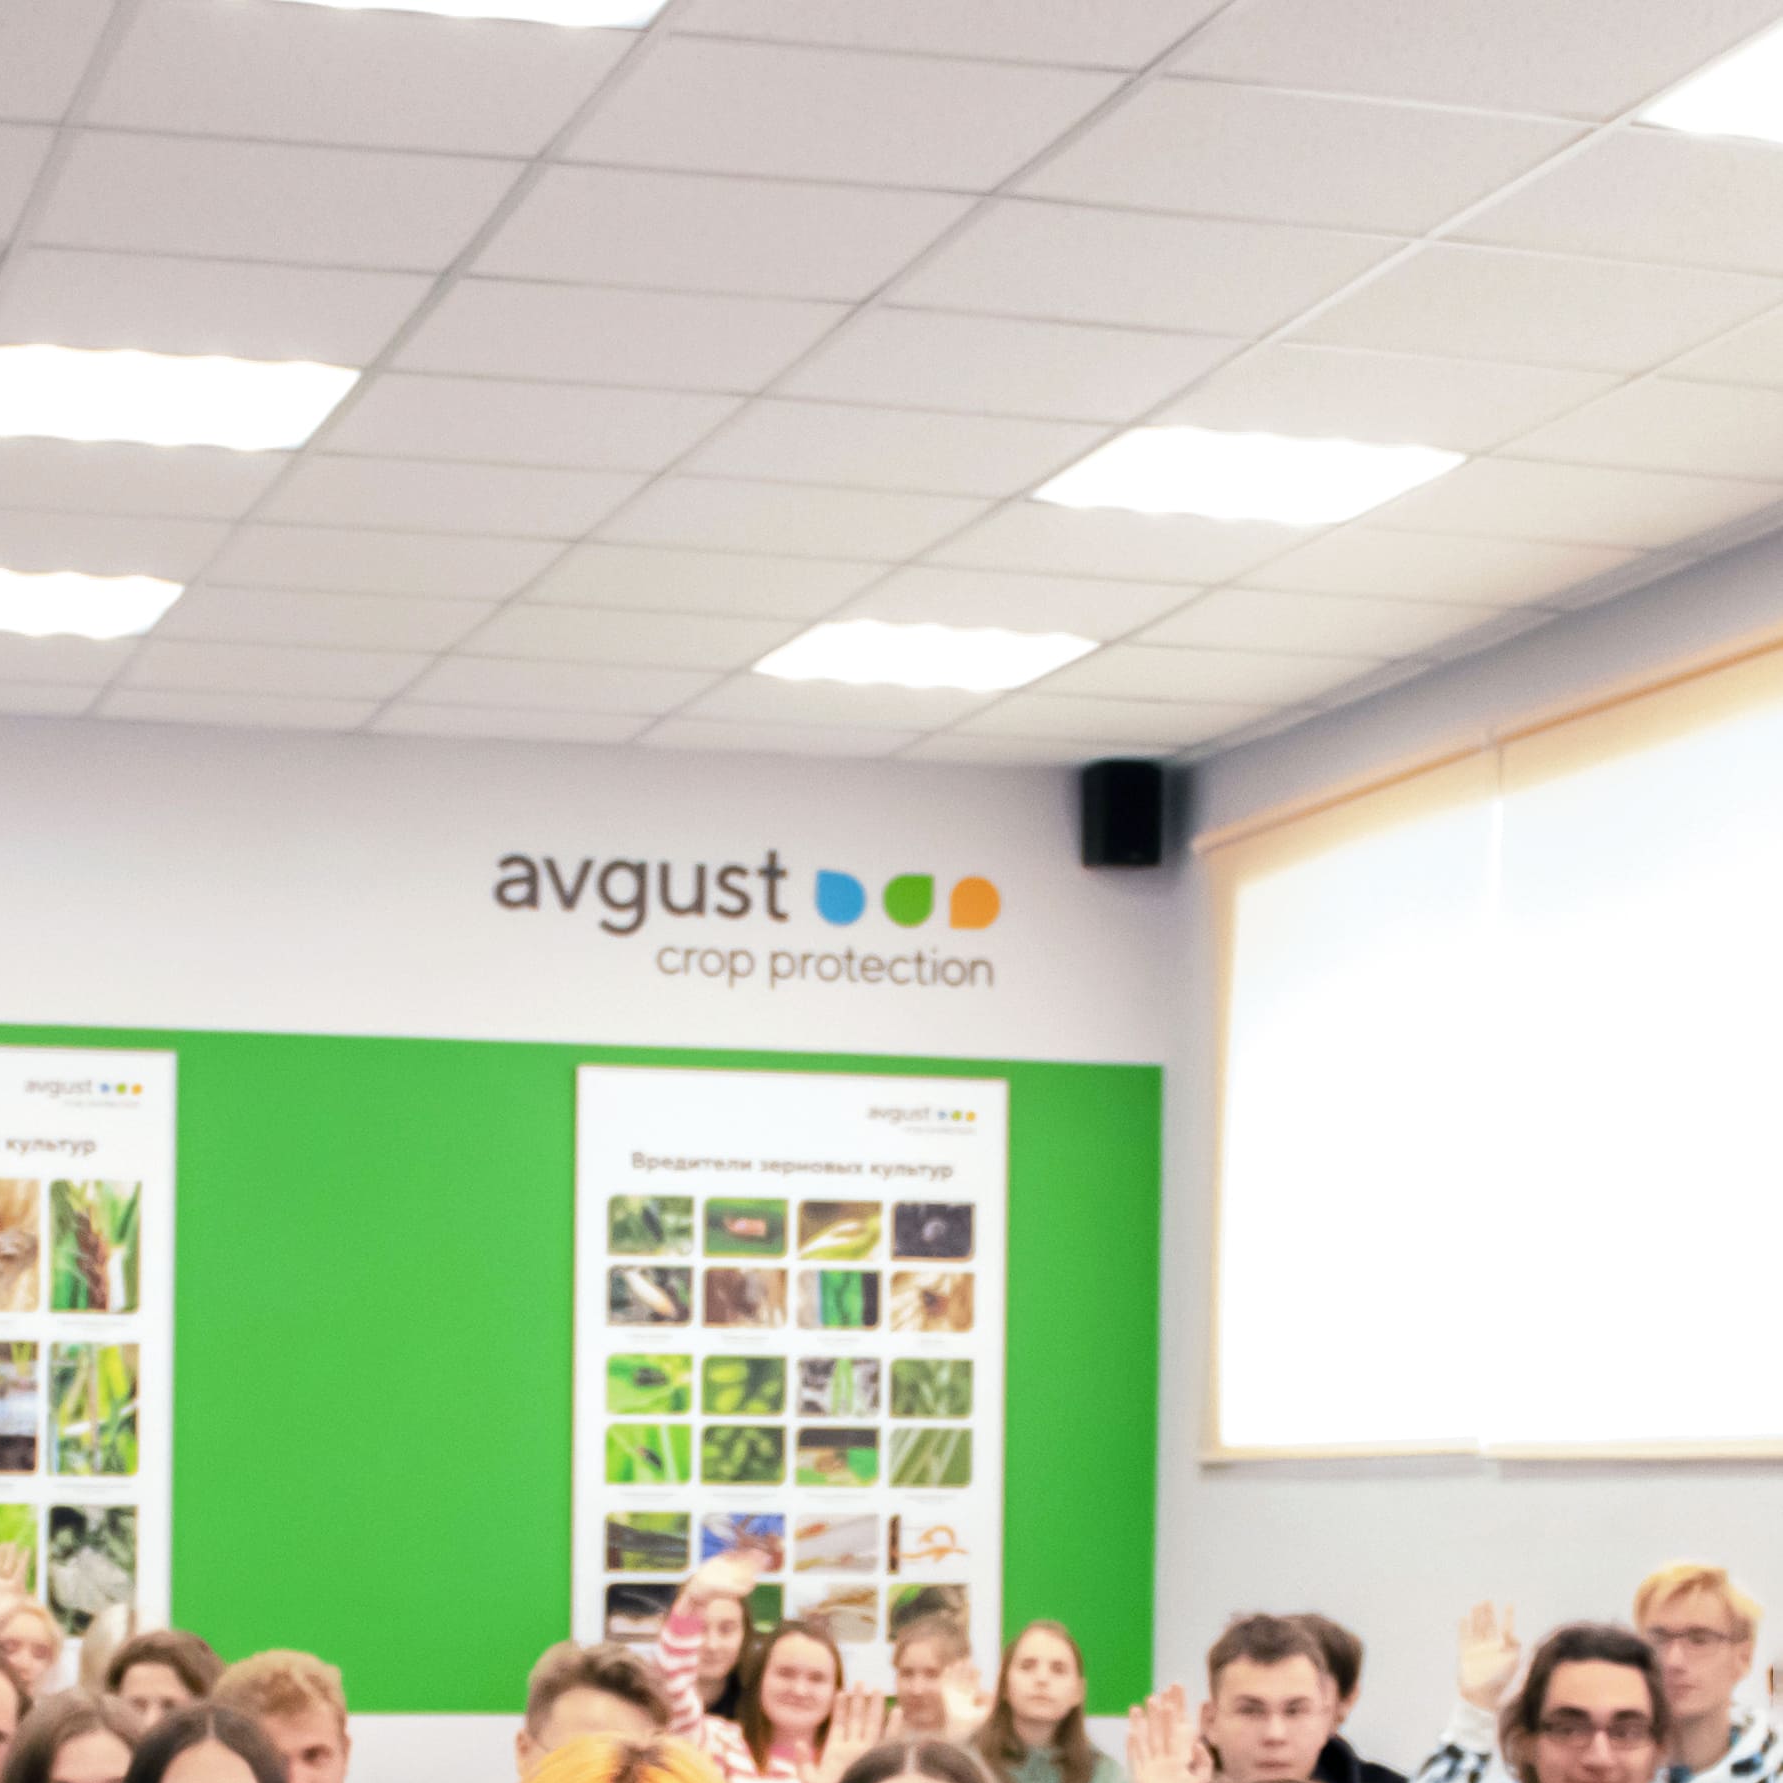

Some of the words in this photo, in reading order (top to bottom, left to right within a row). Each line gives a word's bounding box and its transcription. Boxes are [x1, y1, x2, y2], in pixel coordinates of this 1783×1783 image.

[493, 849, 790, 936] avgust
[655, 944, 756, 989] crop
[769, 946, 995, 988] protection
[24, 1078, 93, 1099] avgust
[866, 1103, 931, 1125] avgust
[5, 1136, 97, 1157] культур
[631, 1151, 753, 1173] Вредители
[760, 1158, 863, 1178] зерновых
[869, 1162, 954, 1181] культур
